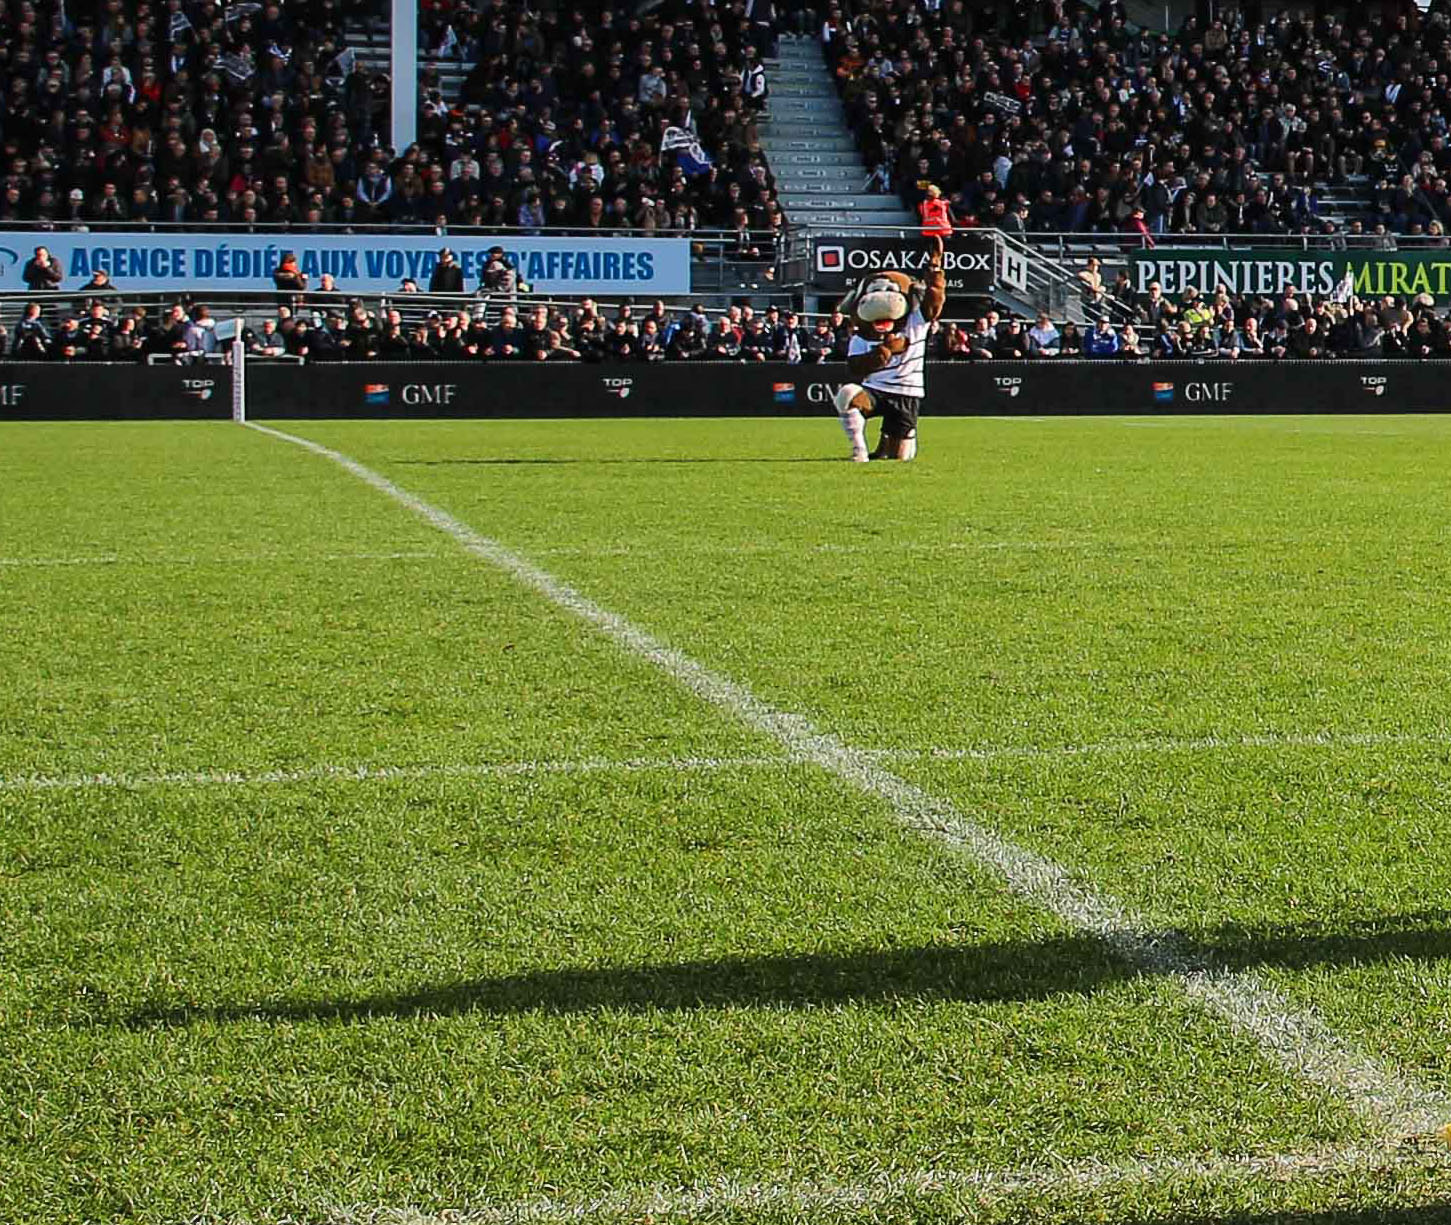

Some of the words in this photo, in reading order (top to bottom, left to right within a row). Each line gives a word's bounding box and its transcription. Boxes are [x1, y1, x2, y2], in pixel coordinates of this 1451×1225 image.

[68, 248, 186, 278] AGENCE
[194, 244, 288, 278] DÉDIÉ
[301, 249, 358, 279] AUX
[365, 251, 484, 279] VOYAES
[847, 249, 932, 270] OSAKA
[943, 253, 992, 271] BOX
[1008, 254, 1021, 283] H
[1135, 260, 1334, 295] PEPINIERES
[602, 377, 634, 387] TOP
[993, 377, 1022, 387] TOP
[1184, 382, 1235, 402] GMF
[1360, 376, 1388, 386] TOP
[401, 383, 457, 405] GMF
